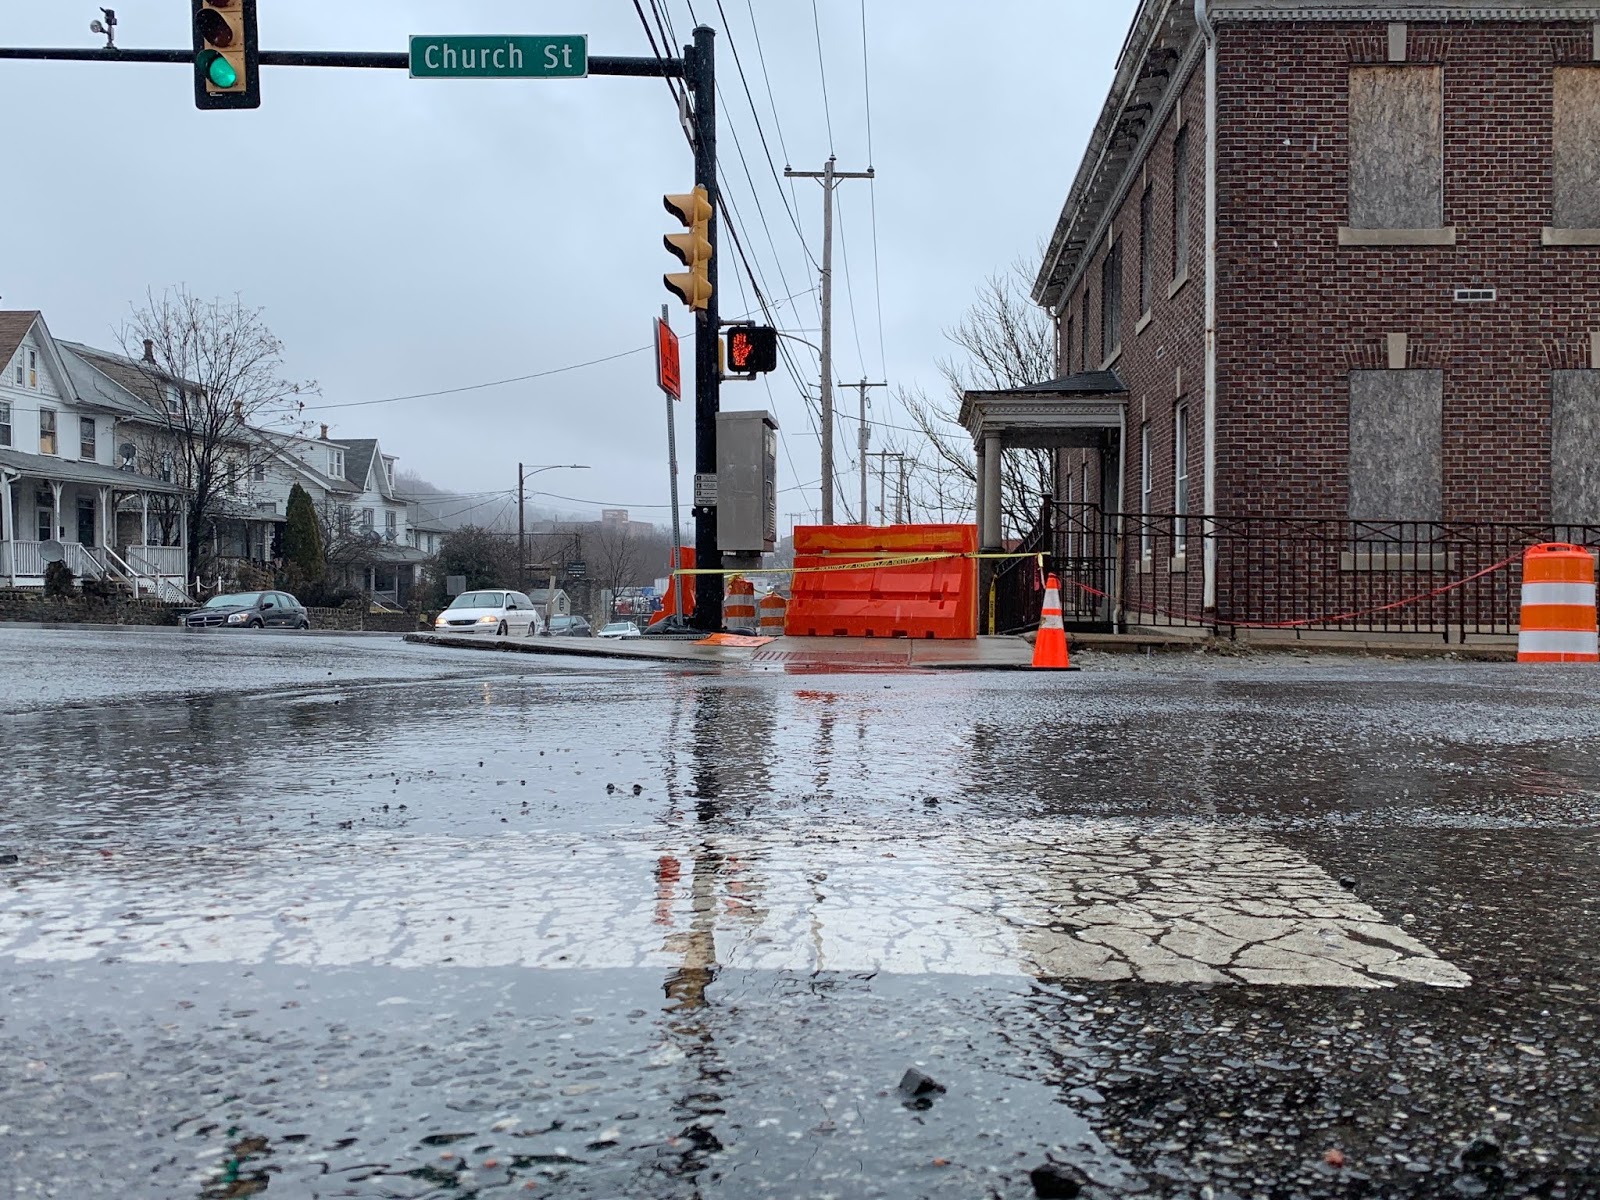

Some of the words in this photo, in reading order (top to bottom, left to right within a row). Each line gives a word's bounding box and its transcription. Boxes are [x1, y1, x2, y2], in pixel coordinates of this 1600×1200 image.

[424, 43, 523, 69] Church
[543, 44, 573, 69] St
[663, 354, 679, 377] DET
